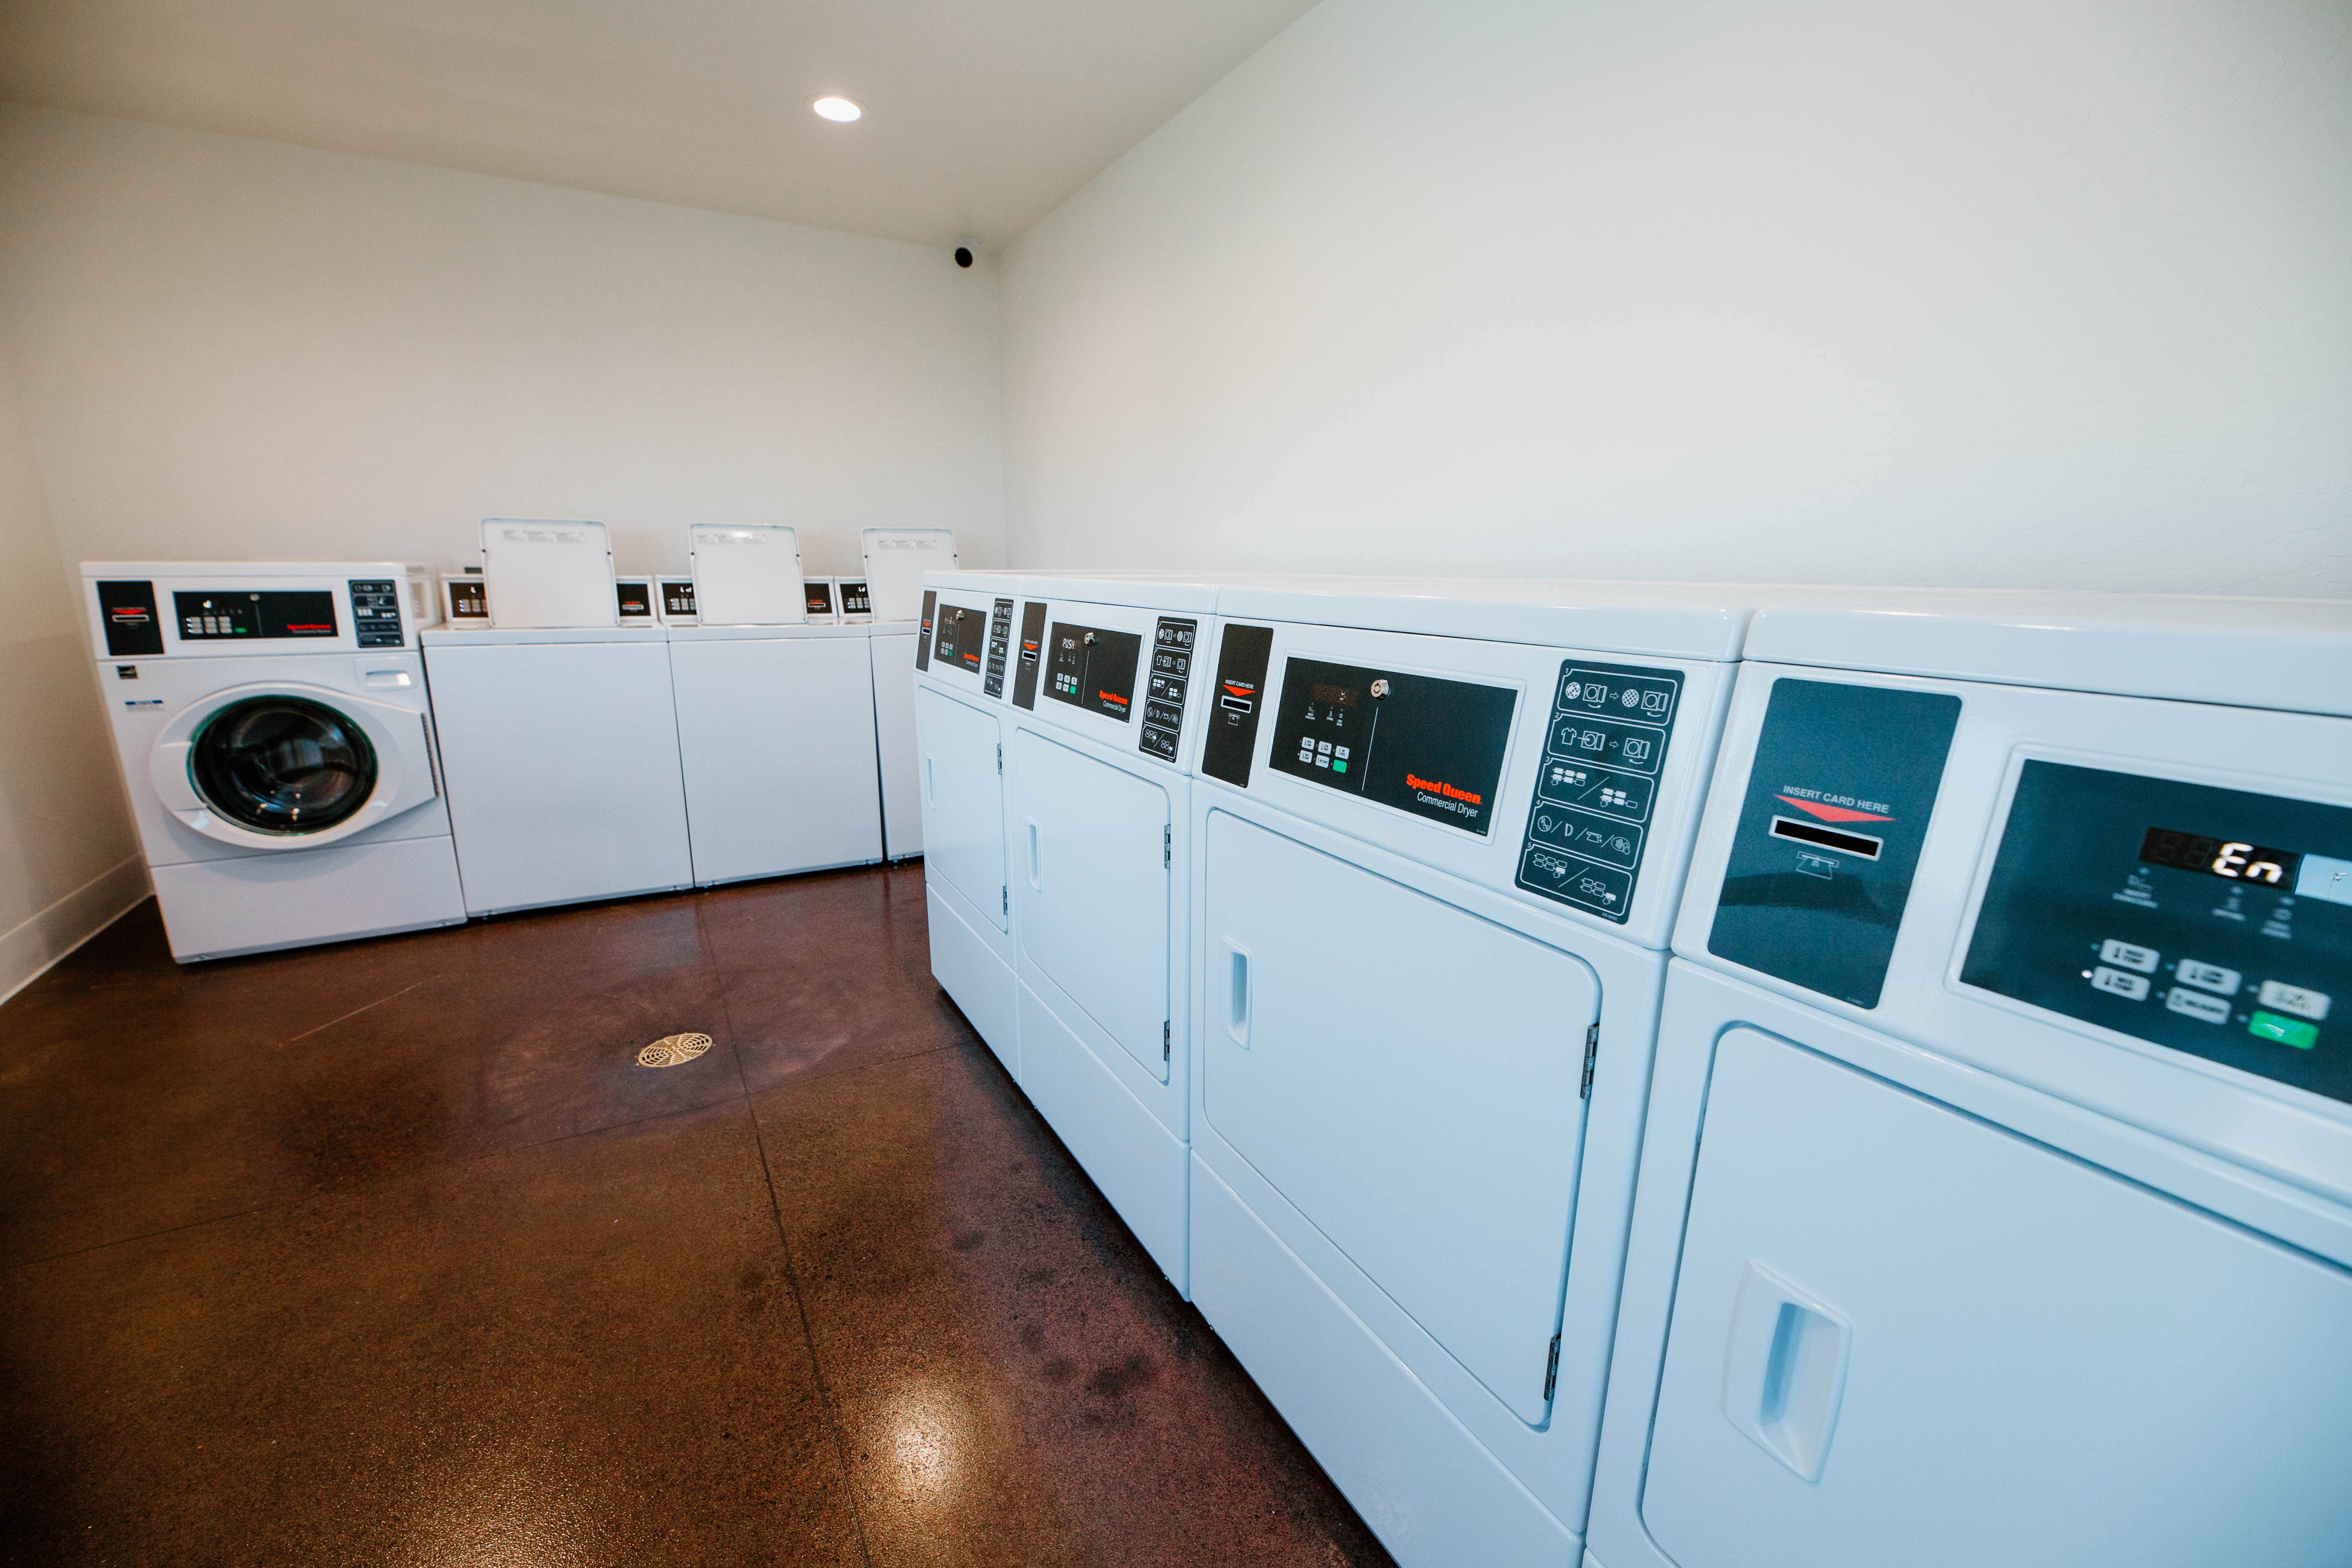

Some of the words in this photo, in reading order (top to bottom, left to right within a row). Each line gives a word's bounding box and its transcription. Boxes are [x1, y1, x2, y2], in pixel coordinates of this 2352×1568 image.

[1062, 638, 1075, 649] PUSH
[1099, 690, 1113, 701] Speed
[1113, 693, 1128, 705] Queen
[1406, 774, 1442, 794] Speed
[1442, 783, 1481, 805] Queen
[1783, 785, 1822, 800] INSERT
[1823, 793, 1855, 806] CARD
[1857, 799, 1891, 814] HERE
[1417, 791, 1457, 811] Commercial
[1457, 803, 1478, 817] Dryer
[2211, 842, 2283, 883] En
